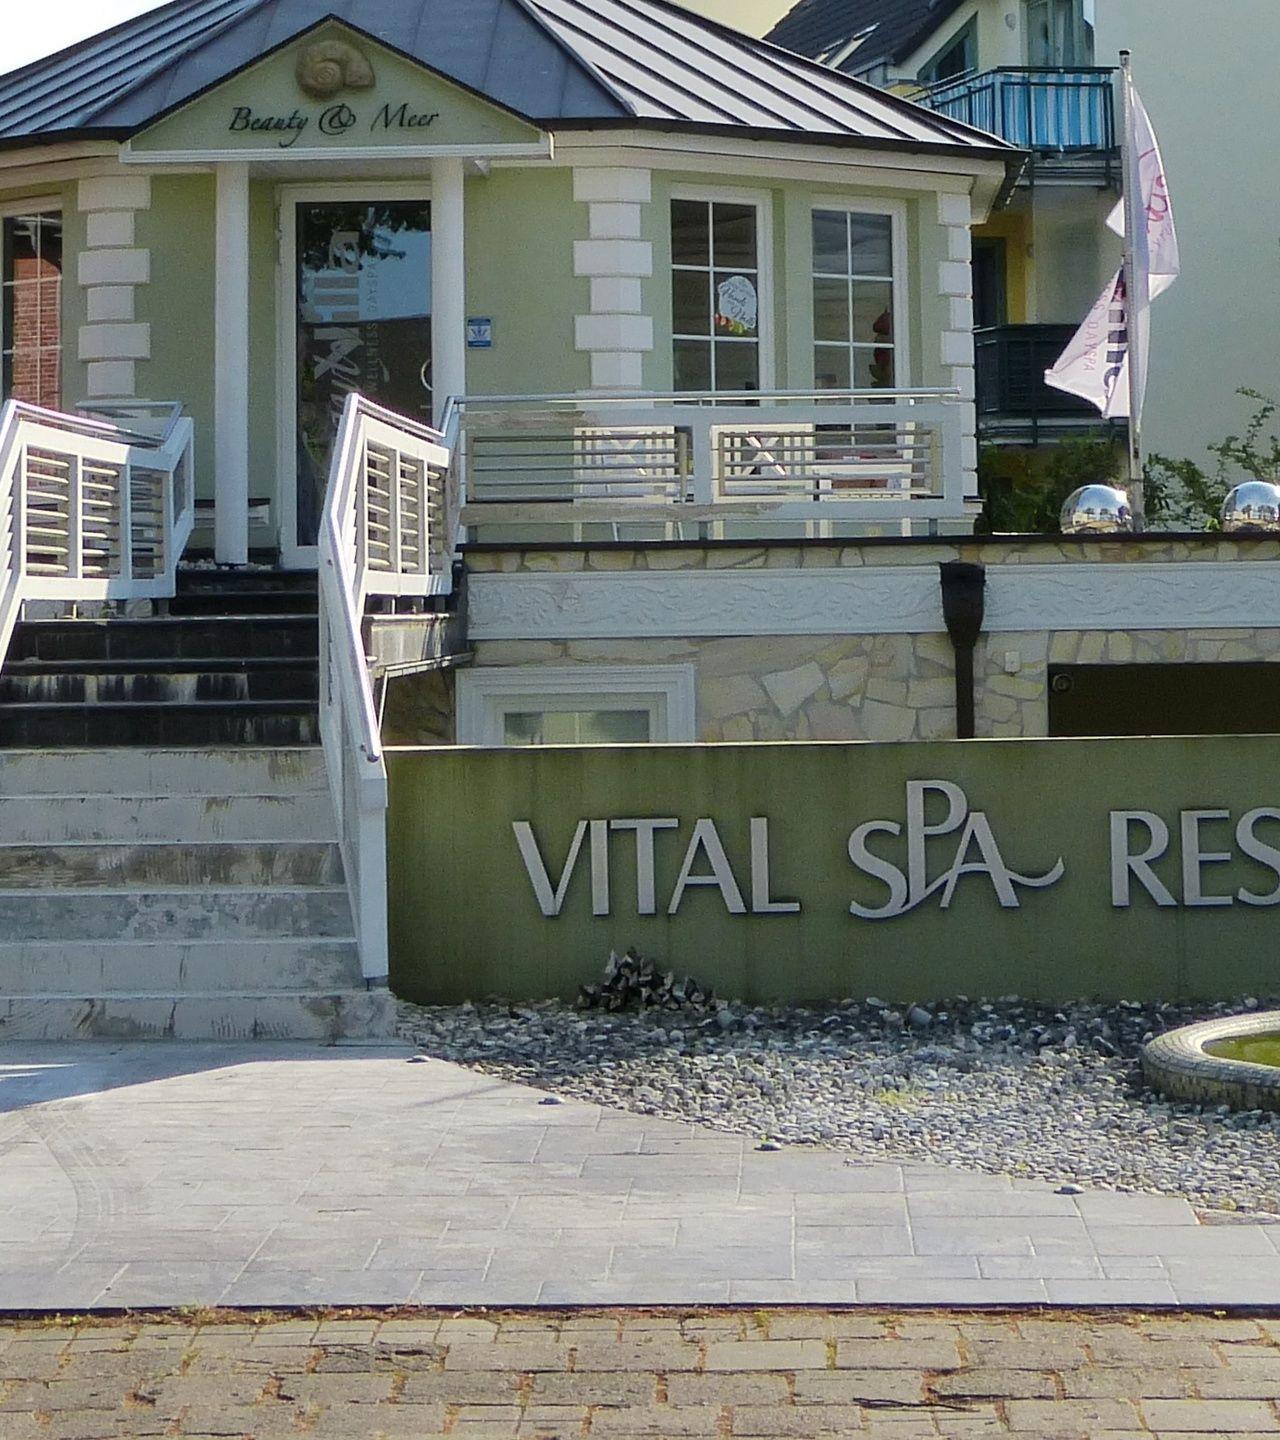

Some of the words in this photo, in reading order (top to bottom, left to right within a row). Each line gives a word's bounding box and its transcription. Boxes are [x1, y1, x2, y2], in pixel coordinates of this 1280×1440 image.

[228, 106, 311, 148] Beauty
[370, 103, 439, 131] Meer
[512, 816, 801, 916] VITAL
[847, 779, 1065, 919] SPA
